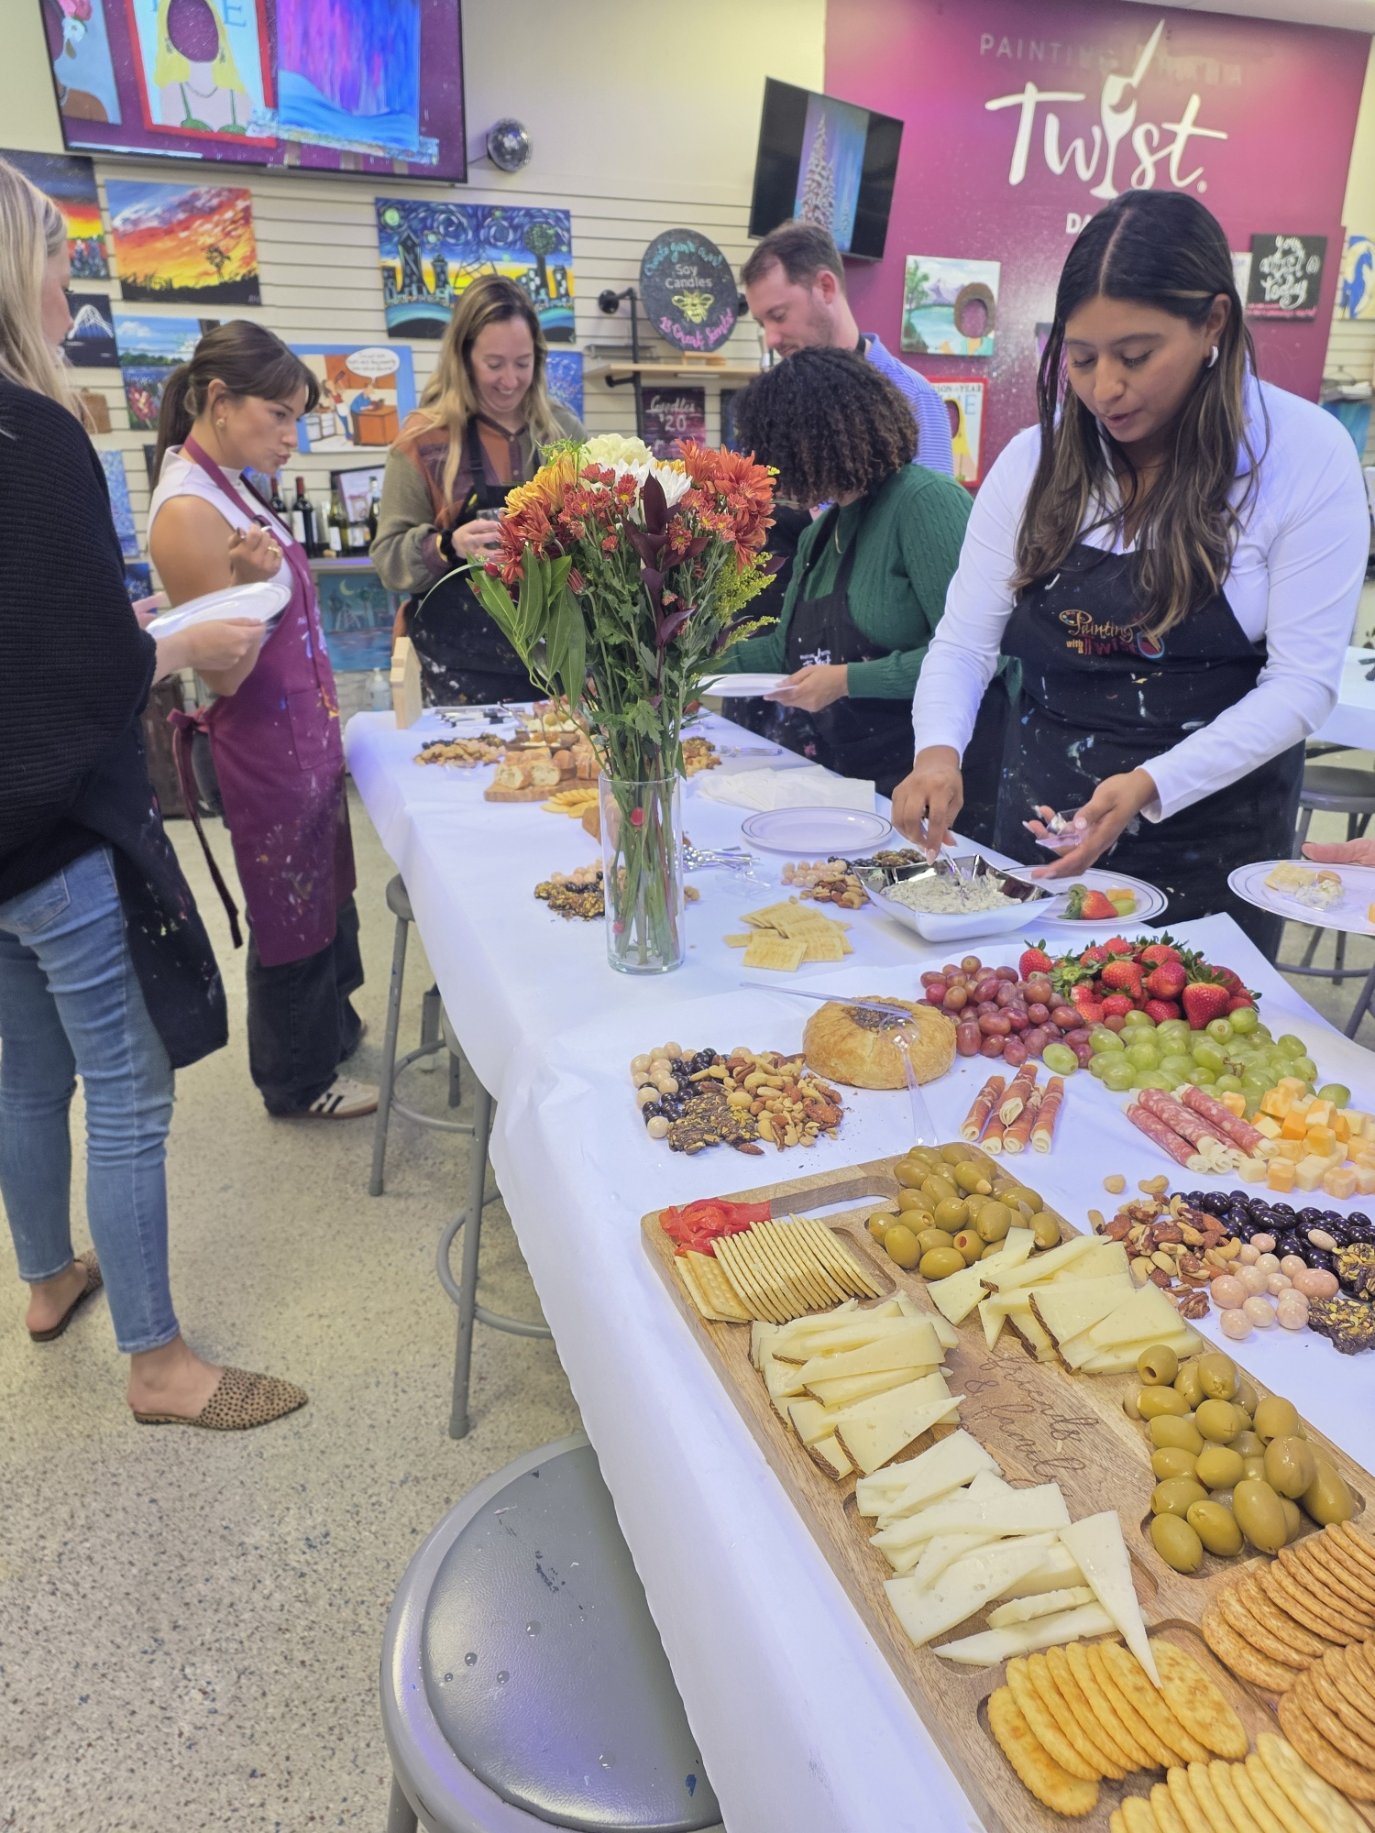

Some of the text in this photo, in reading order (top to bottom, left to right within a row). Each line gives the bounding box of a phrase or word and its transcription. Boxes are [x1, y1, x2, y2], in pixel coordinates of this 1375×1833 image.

[675, 263, 698, 277] Soy
[665, 277, 713, 289] Candles
[978, 1352, 1100, 1443] friends
